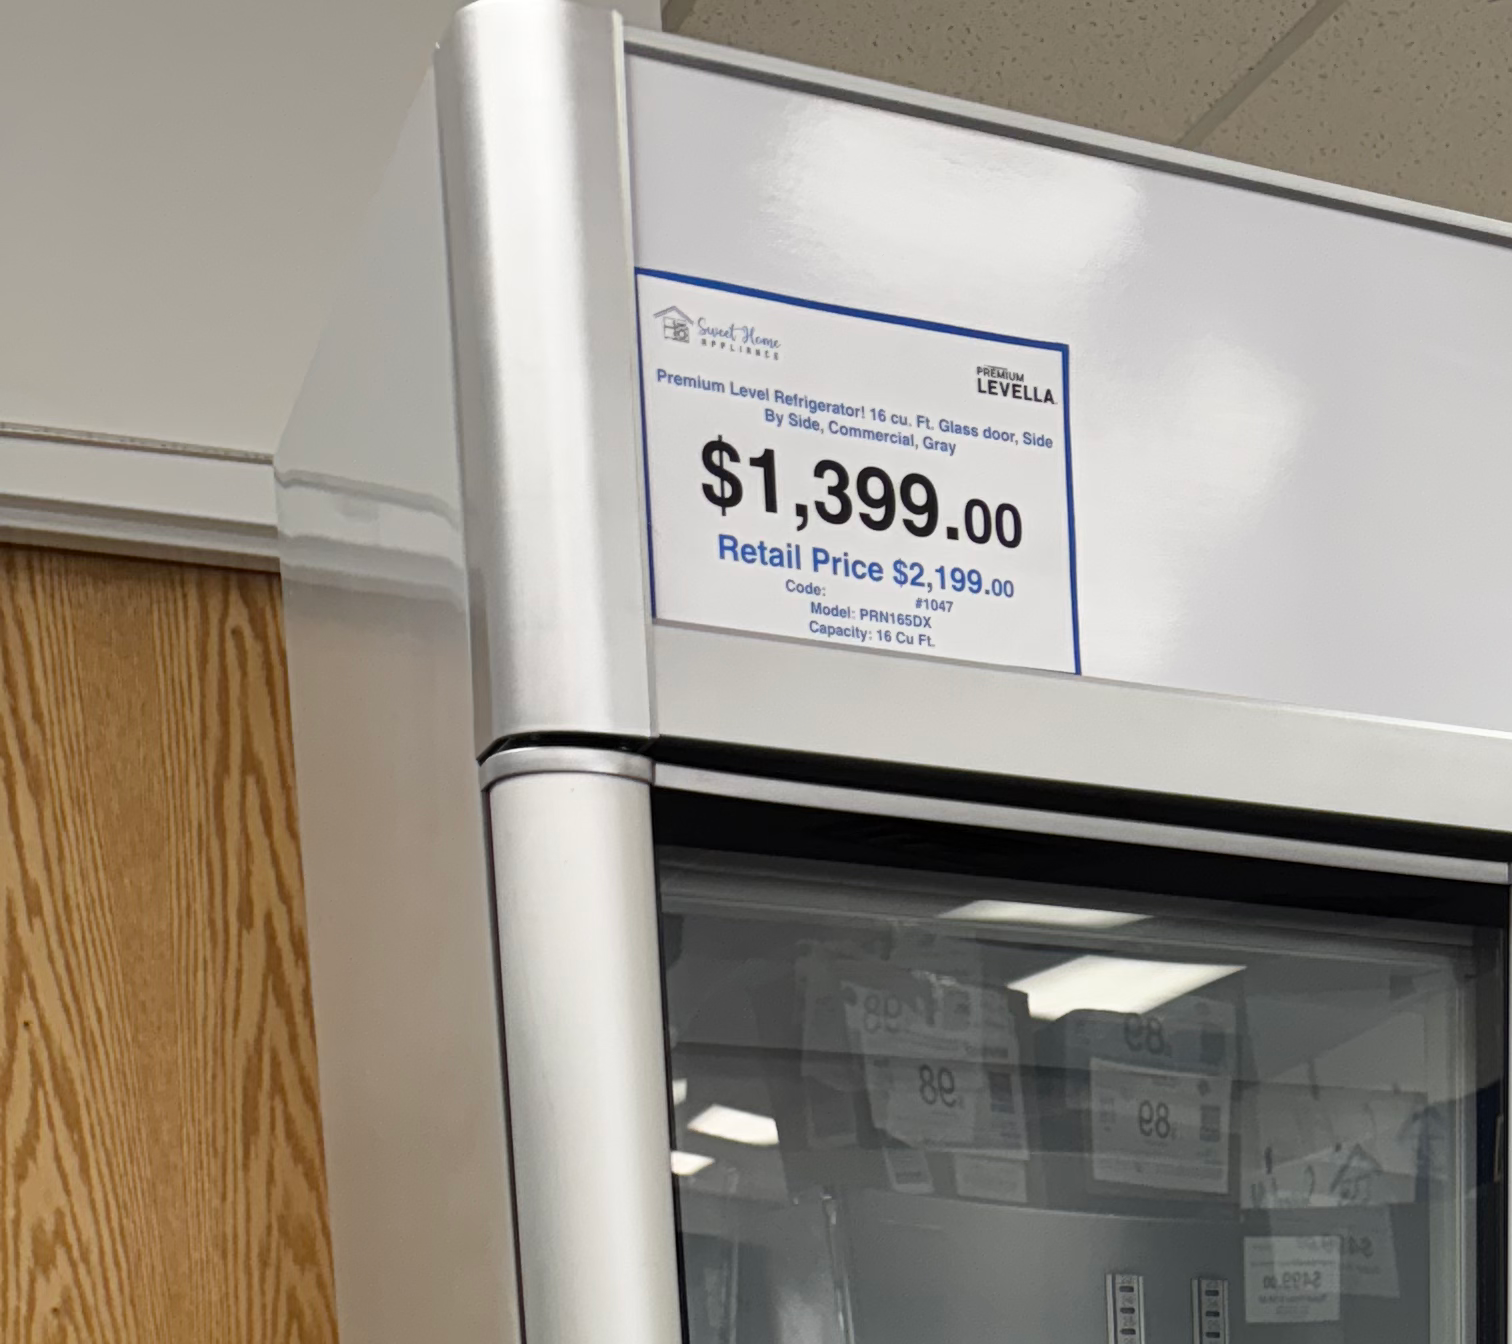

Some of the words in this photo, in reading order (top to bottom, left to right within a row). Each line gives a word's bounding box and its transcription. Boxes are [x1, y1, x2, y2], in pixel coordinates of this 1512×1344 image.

[698, 317, 736, 341] Sweet
[742, 325, 781, 348] Home
[976, 365, 1025, 382] PREMIUM
[977, 378, 1056, 405] LEVELLA
[656, 368, 725, 393] Premium
[730, 381, 770, 401] Level
[774, 390, 866, 419] Refrigerator!
[870, 408, 887, 423] 16
[891, 413, 912, 427] cu.
[916, 415, 935, 431] Ft.
[939, 419, 979, 437] Glass
[983, 427, 1019, 446] door,
[1023, 431, 1054, 449] Side
[765, 408, 784, 428] By
[789, 412, 825, 434] Side,
[828, 420, 919, 450] Commercial,
[923, 436, 957, 456] Gray
[701, 434, 1022, 549] $1,399.00
[718, 534, 802, 571] Retail
[812, 547, 884, 582] Price
[893, 558, 1015, 598] $2,199.00
[785, 579, 826, 597] Code:
[810, 602, 856, 620] Model:
[859, 608, 933, 629] PRN165DX
[915, 597, 954, 613] #1047
[809, 620, 873, 642] Capacity:
[876, 629, 892, 643] 16
[895, 631, 915, 645] Cu
[918, 633, 936, 648] Ft.
